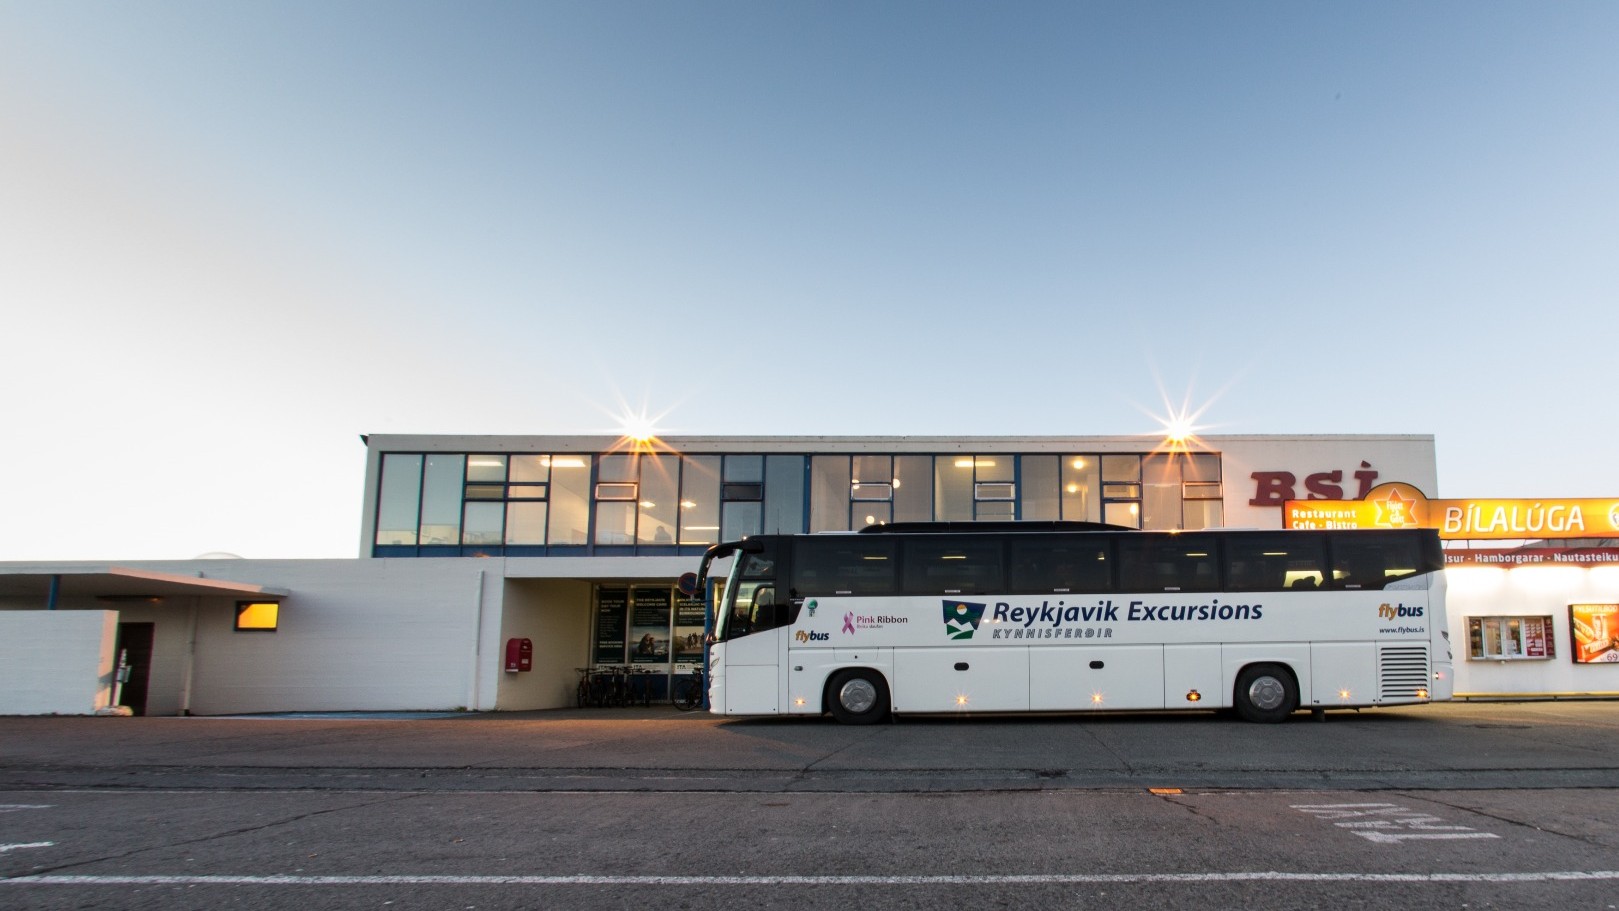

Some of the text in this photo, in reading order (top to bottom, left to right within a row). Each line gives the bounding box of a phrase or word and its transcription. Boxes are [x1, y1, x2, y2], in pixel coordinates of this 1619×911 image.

[1292, 509, 1357, 518] Restaurant
[1444, 502, 1585, 533] BÍLALÚGA
[1292, 520, 1316, 529] Cafe
[1326, 520, 1358, 529] Bistro
[1474, 553, 1544, 564] Hamborgarar
[993, 599, 1263, 628] Reykjavik Excursions
[1378, 603, 1424, 621] flybus
[856, 615, 908, 624] Pink Ribbon
[992, 628, 1113, 639] KYNNISFERÐIR
[1379, 626, 1425, 635] www.flybus.is
[795, 630, 830, 643] flybus
